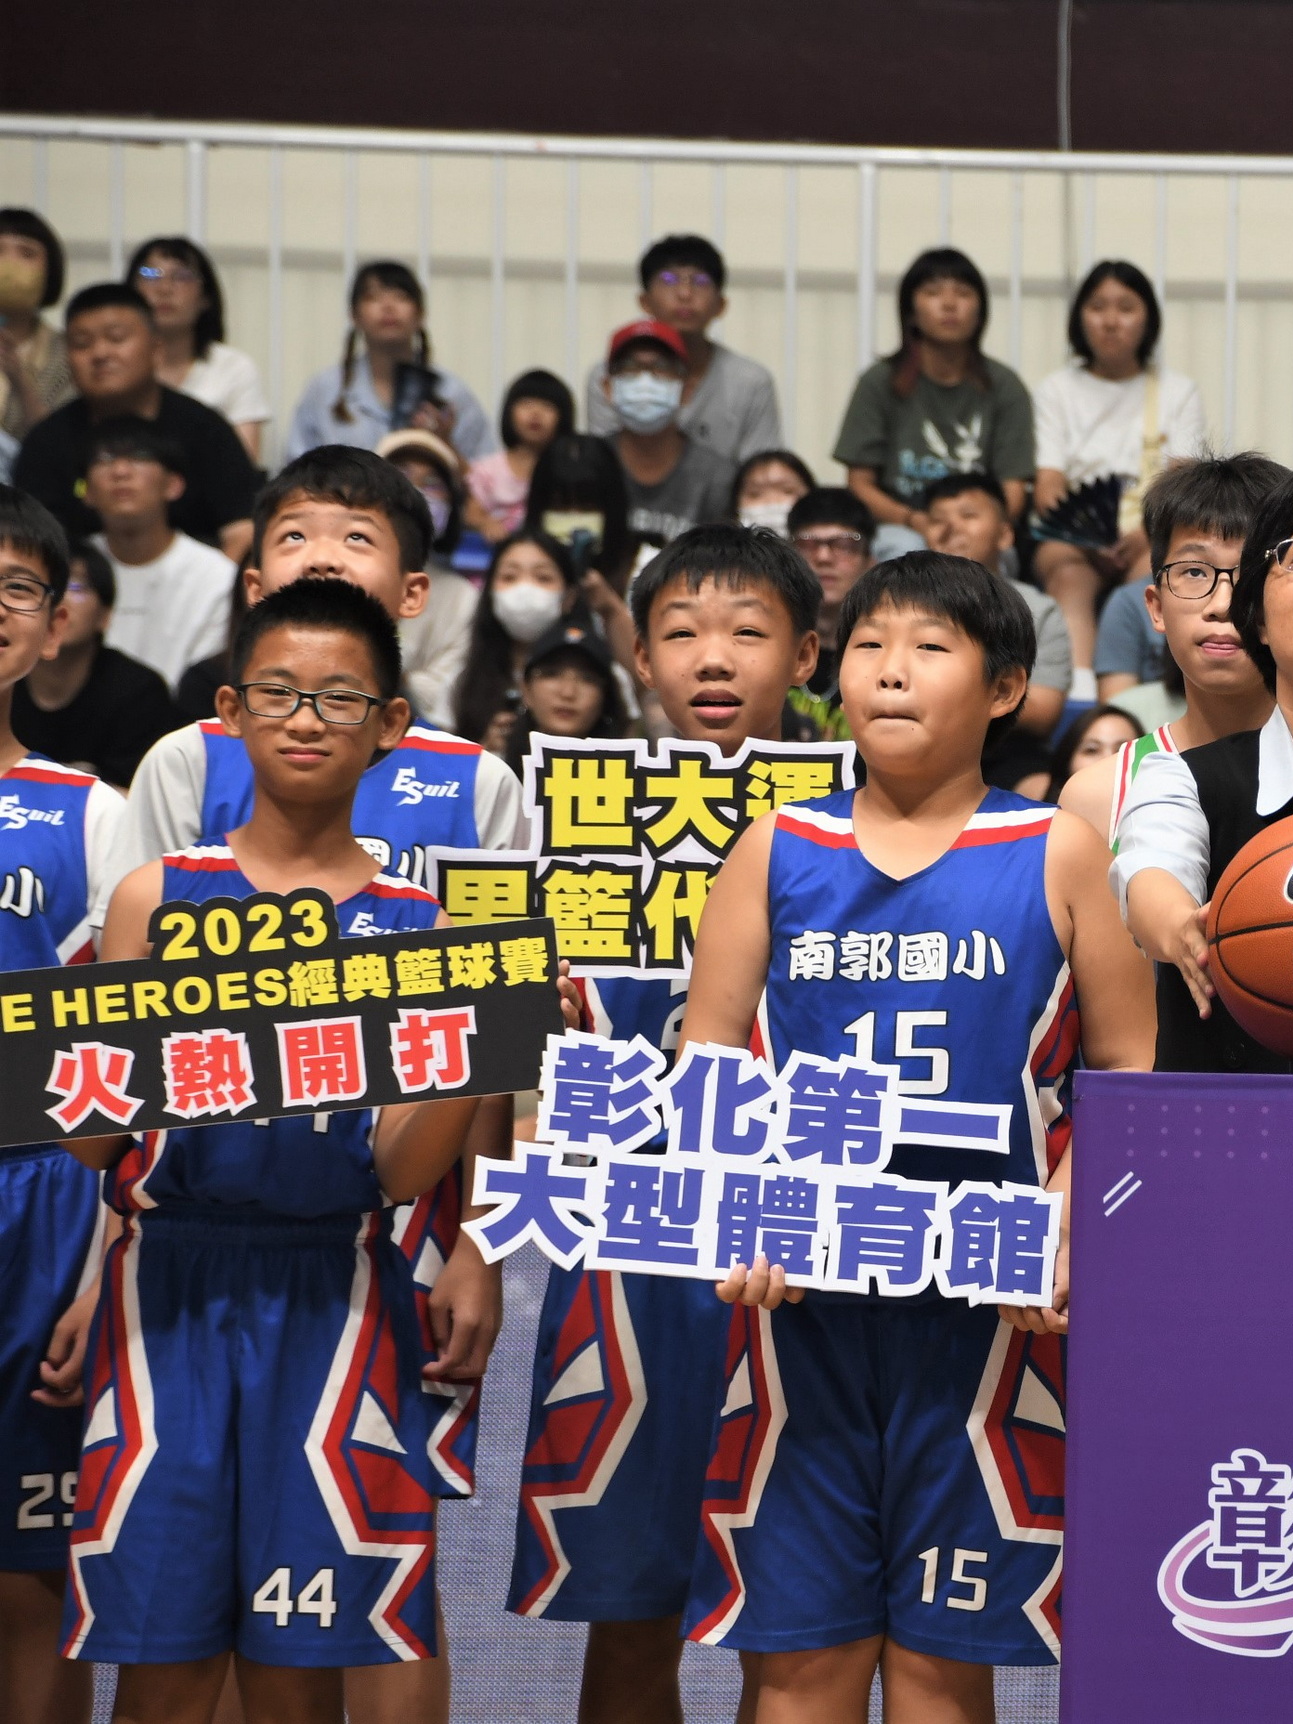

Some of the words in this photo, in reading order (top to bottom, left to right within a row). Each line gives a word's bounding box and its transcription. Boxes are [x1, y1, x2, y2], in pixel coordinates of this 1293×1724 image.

[159, 899, 329, 962] 2023
[789, 929, 1006, 983] 南郭國小
[48, 1008, 474, 1128] 火熱開打
[547, 1042, 1015, 1167] 彰化第一
[478, 1153, 1052, 1295] 大型體育館
[252, 1567, 338, 1629] 44
[918, 1547, 990, 1613] 15
